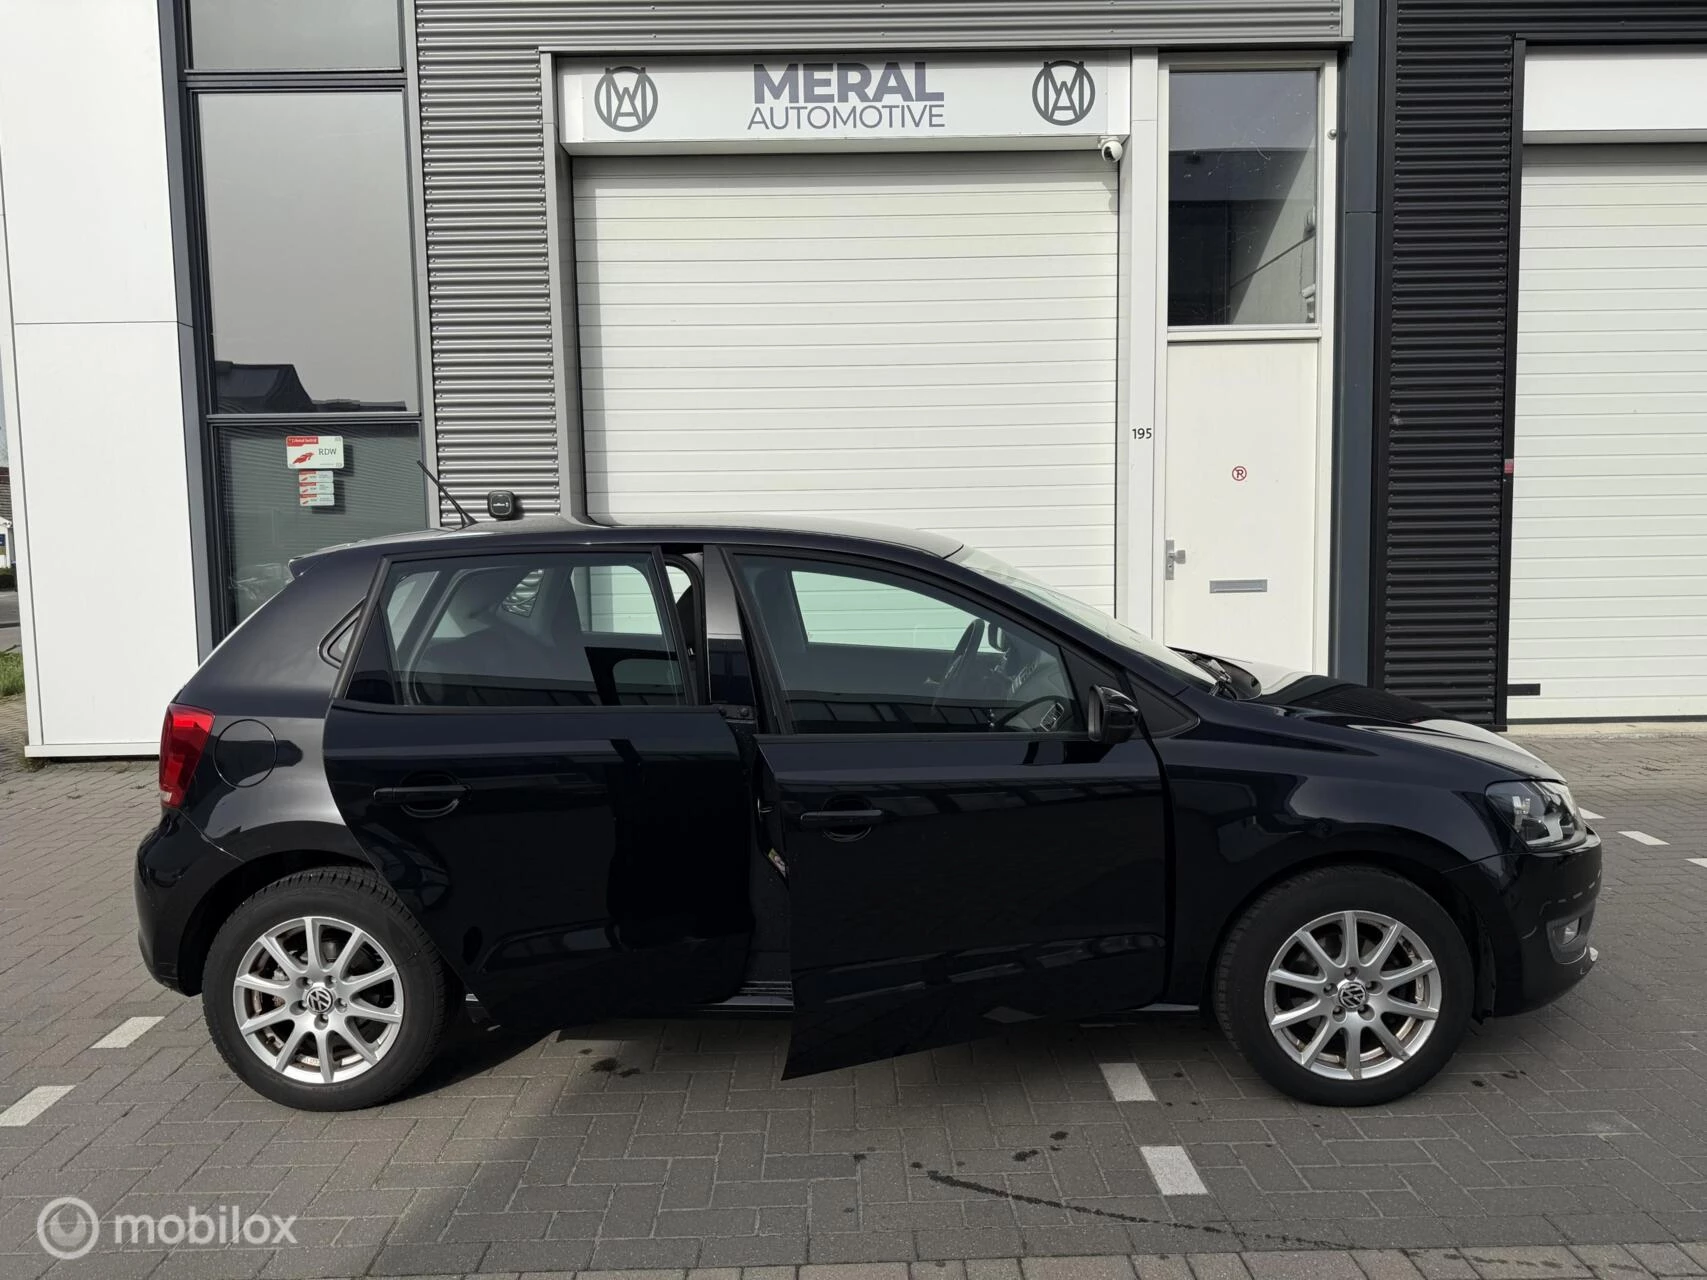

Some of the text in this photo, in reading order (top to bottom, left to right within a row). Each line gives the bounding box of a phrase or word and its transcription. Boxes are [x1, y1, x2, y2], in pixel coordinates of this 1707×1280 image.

[753, 61, 945, 105] MERAL
[747, 104, 946, 130] AUTOMOTIVE
[1132, 427, 1152, 440] 195
[318, 448, 337, 456] RDW
